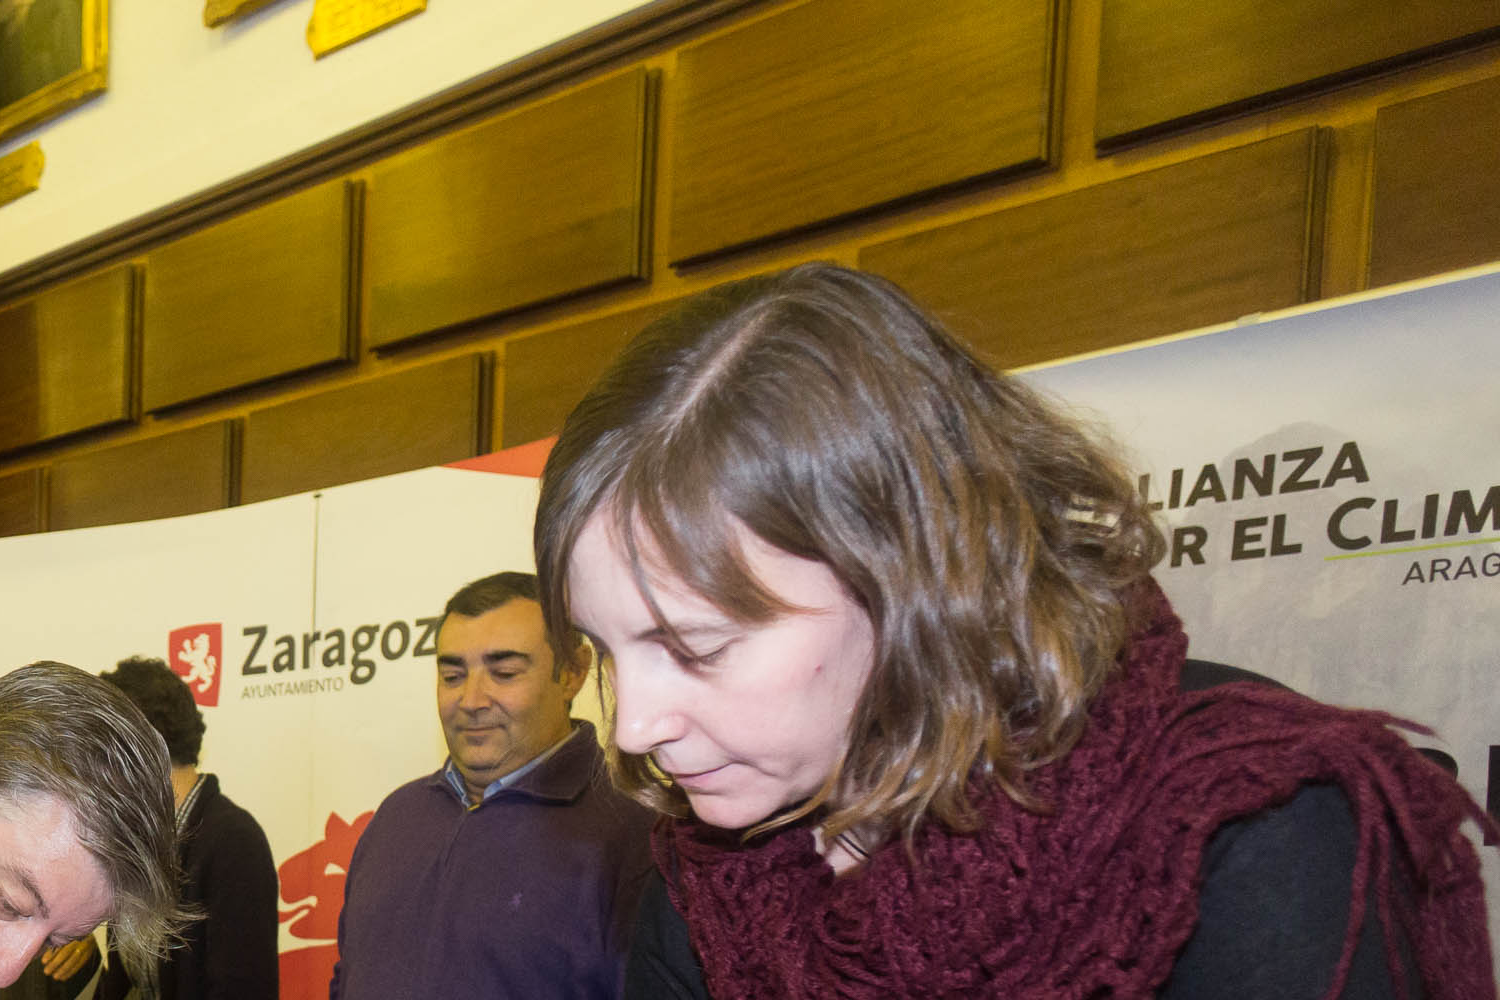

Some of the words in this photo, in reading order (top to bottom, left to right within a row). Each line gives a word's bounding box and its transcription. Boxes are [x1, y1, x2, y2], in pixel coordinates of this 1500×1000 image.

[1138, 441, 1370, 512] LIANZA
[1231, 514, 1303, 561] EL
[1326, 485, 1500, 551] CLIM
[1401, 553, 1500, 586] ARAG
[241, 615, 444, 685] Zaragoz
[241, 677, 345, 700] AYUNTAMIENTO
